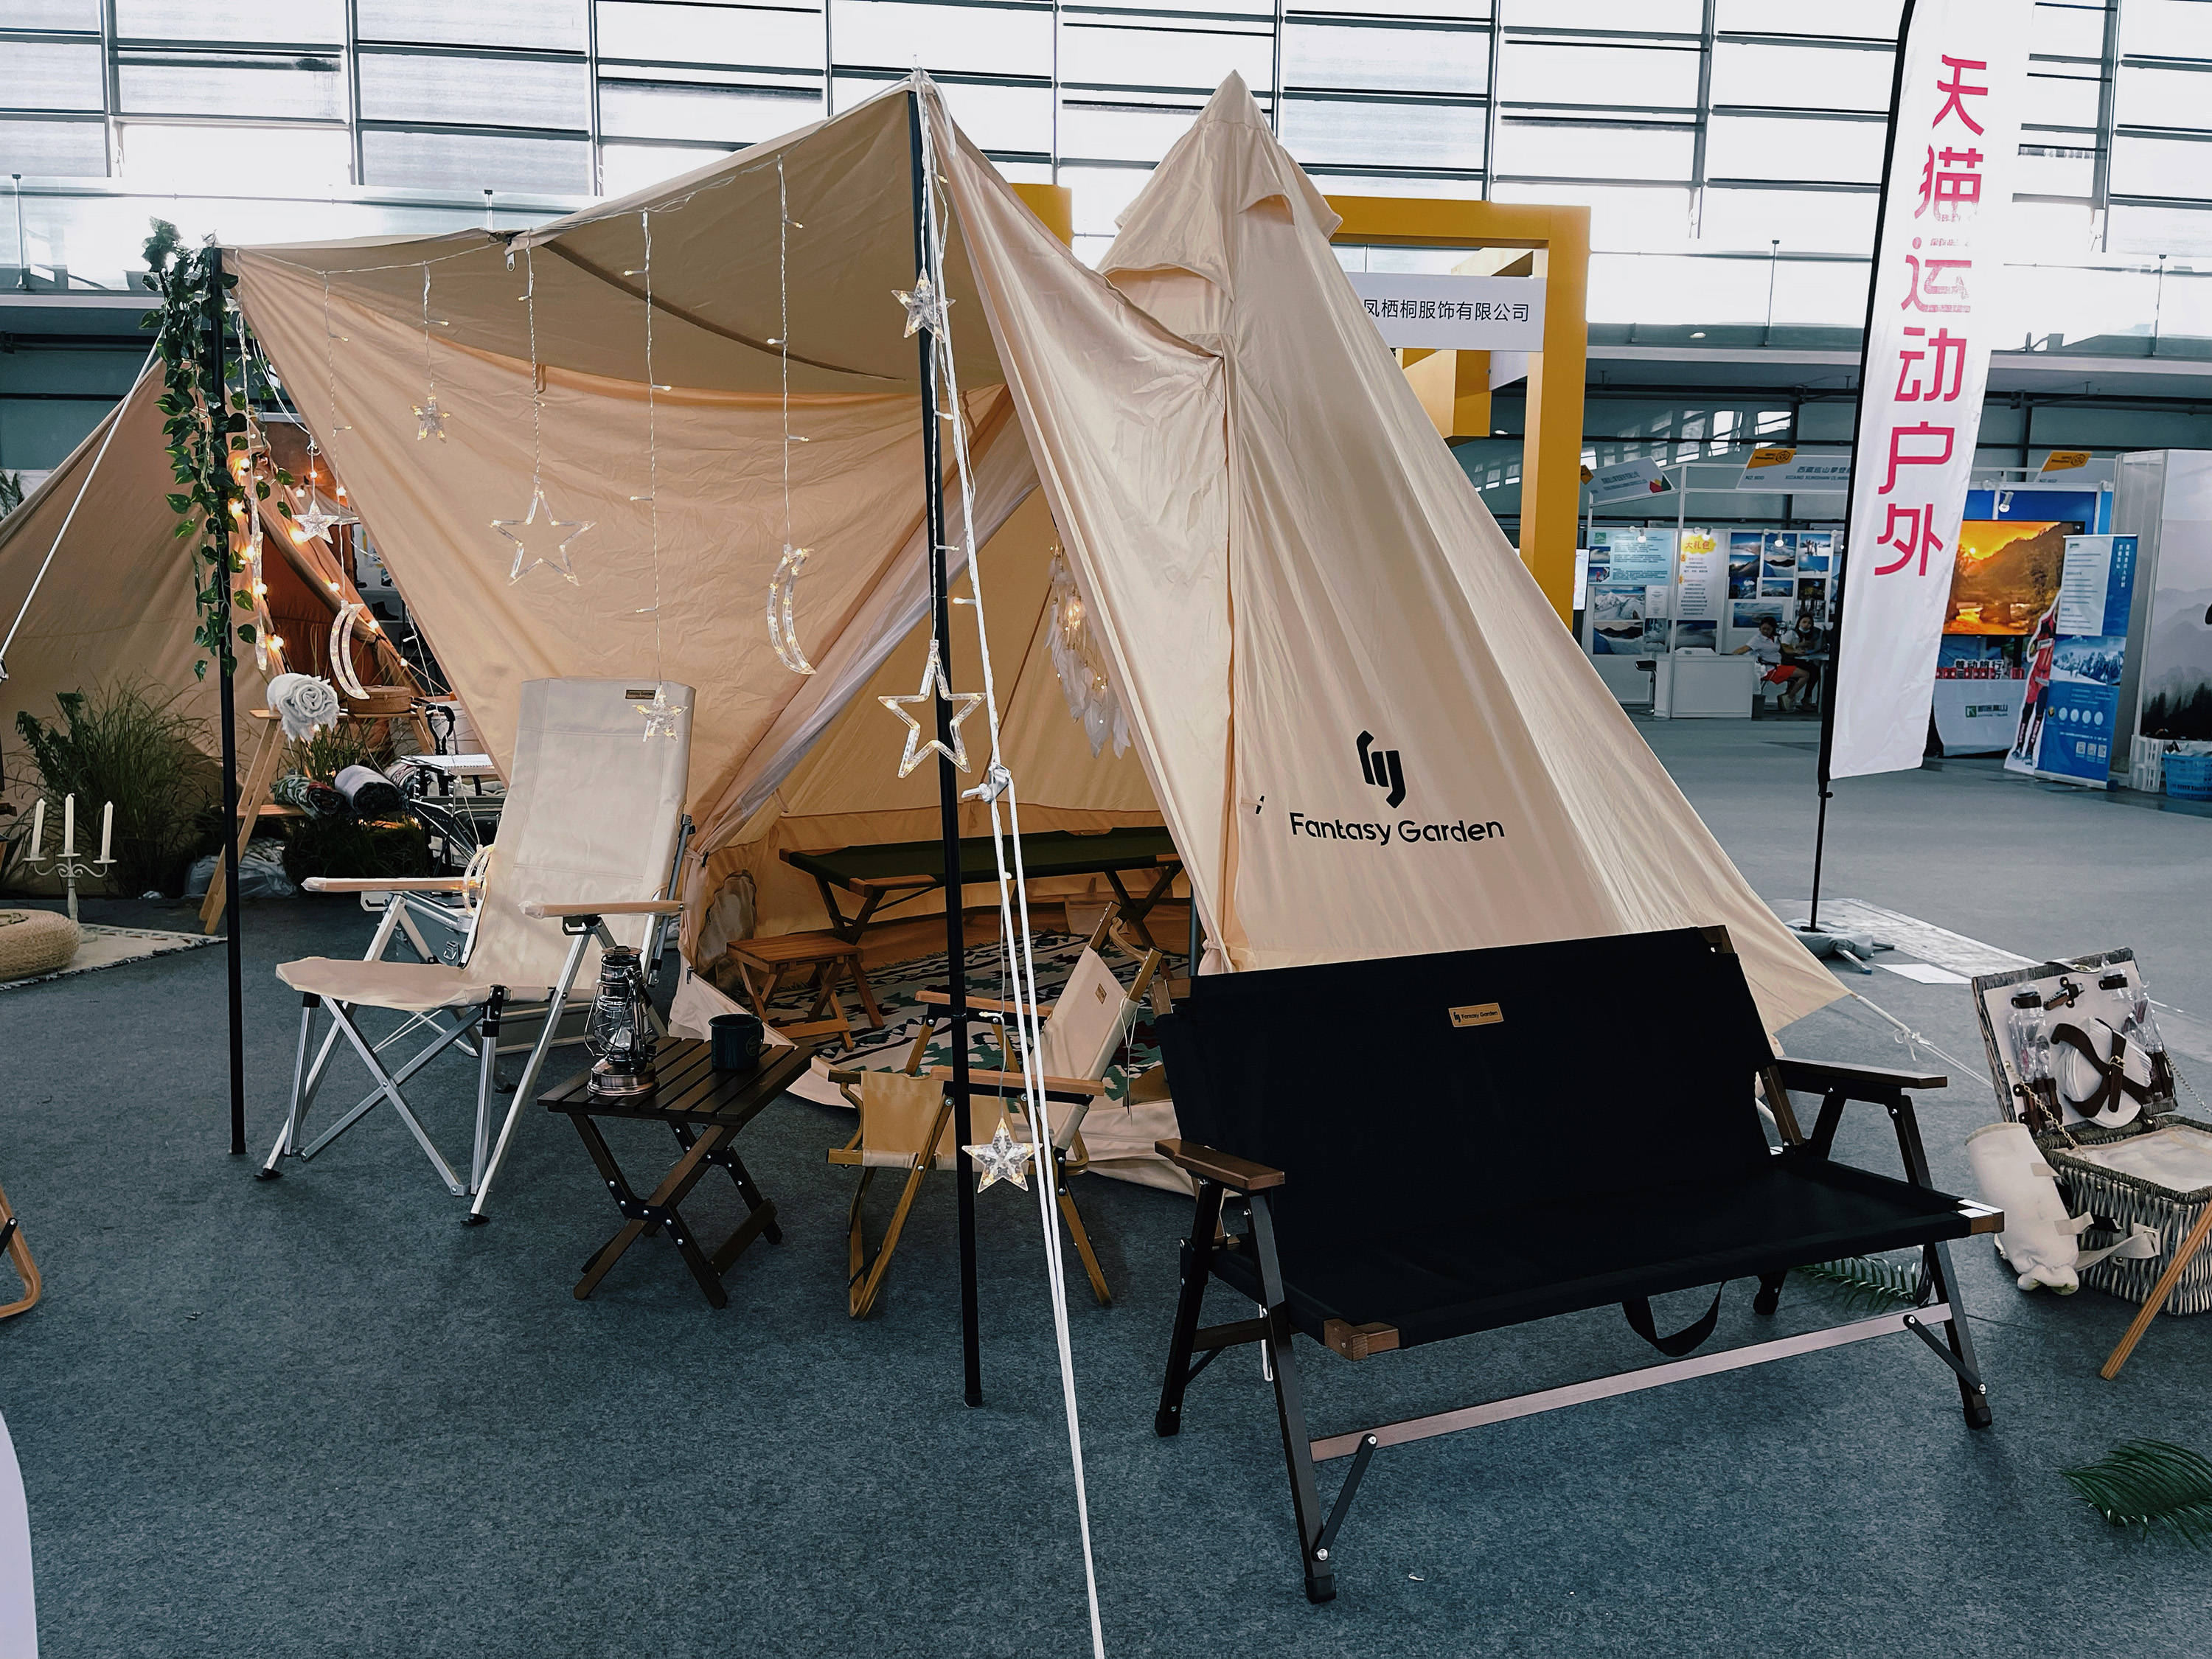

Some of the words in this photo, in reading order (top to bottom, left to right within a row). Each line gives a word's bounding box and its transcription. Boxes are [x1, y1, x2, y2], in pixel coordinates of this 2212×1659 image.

[1363, 298, 1530, 322] 凤栖桐服饰有限公司
[1874, 54, 1989, 577] 天猫运动户外
[1686, 540, 1710, 549] 大礼包
[1289, 812, 1391, 846] Fantasy
[1397, 819, 1505, 843] Garden
